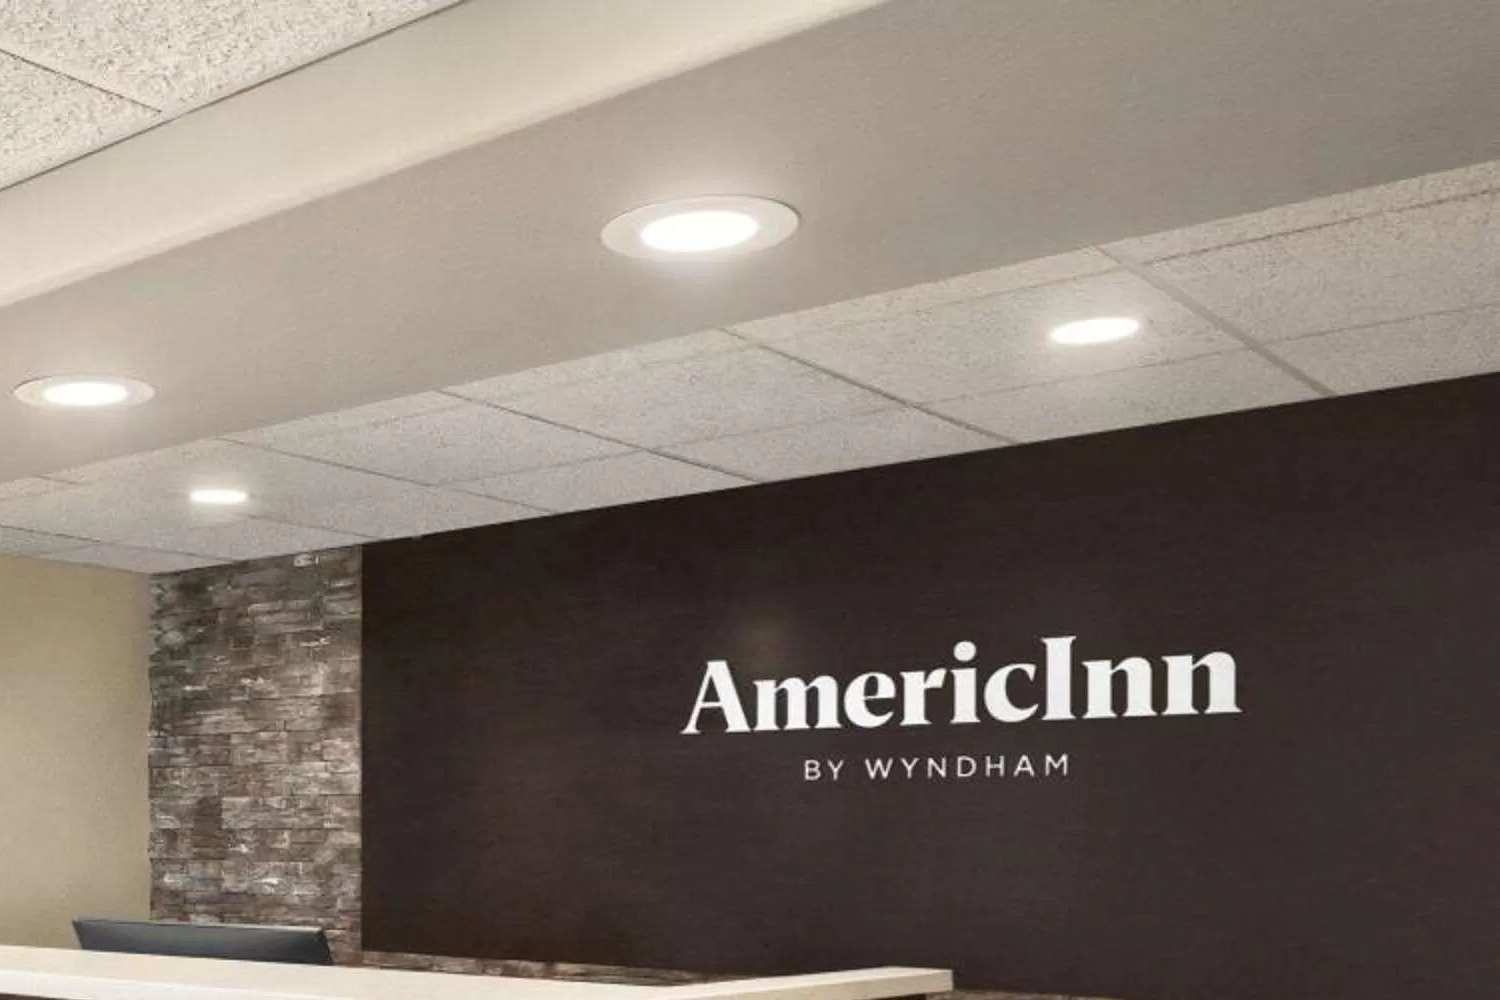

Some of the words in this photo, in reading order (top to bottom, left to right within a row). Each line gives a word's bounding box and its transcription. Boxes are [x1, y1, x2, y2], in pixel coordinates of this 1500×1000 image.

[680, 635, 1243, 735] AmericInn
[804, 758, 845, 781] BY
[864, 753, 1069, 780] WYNDHAM
